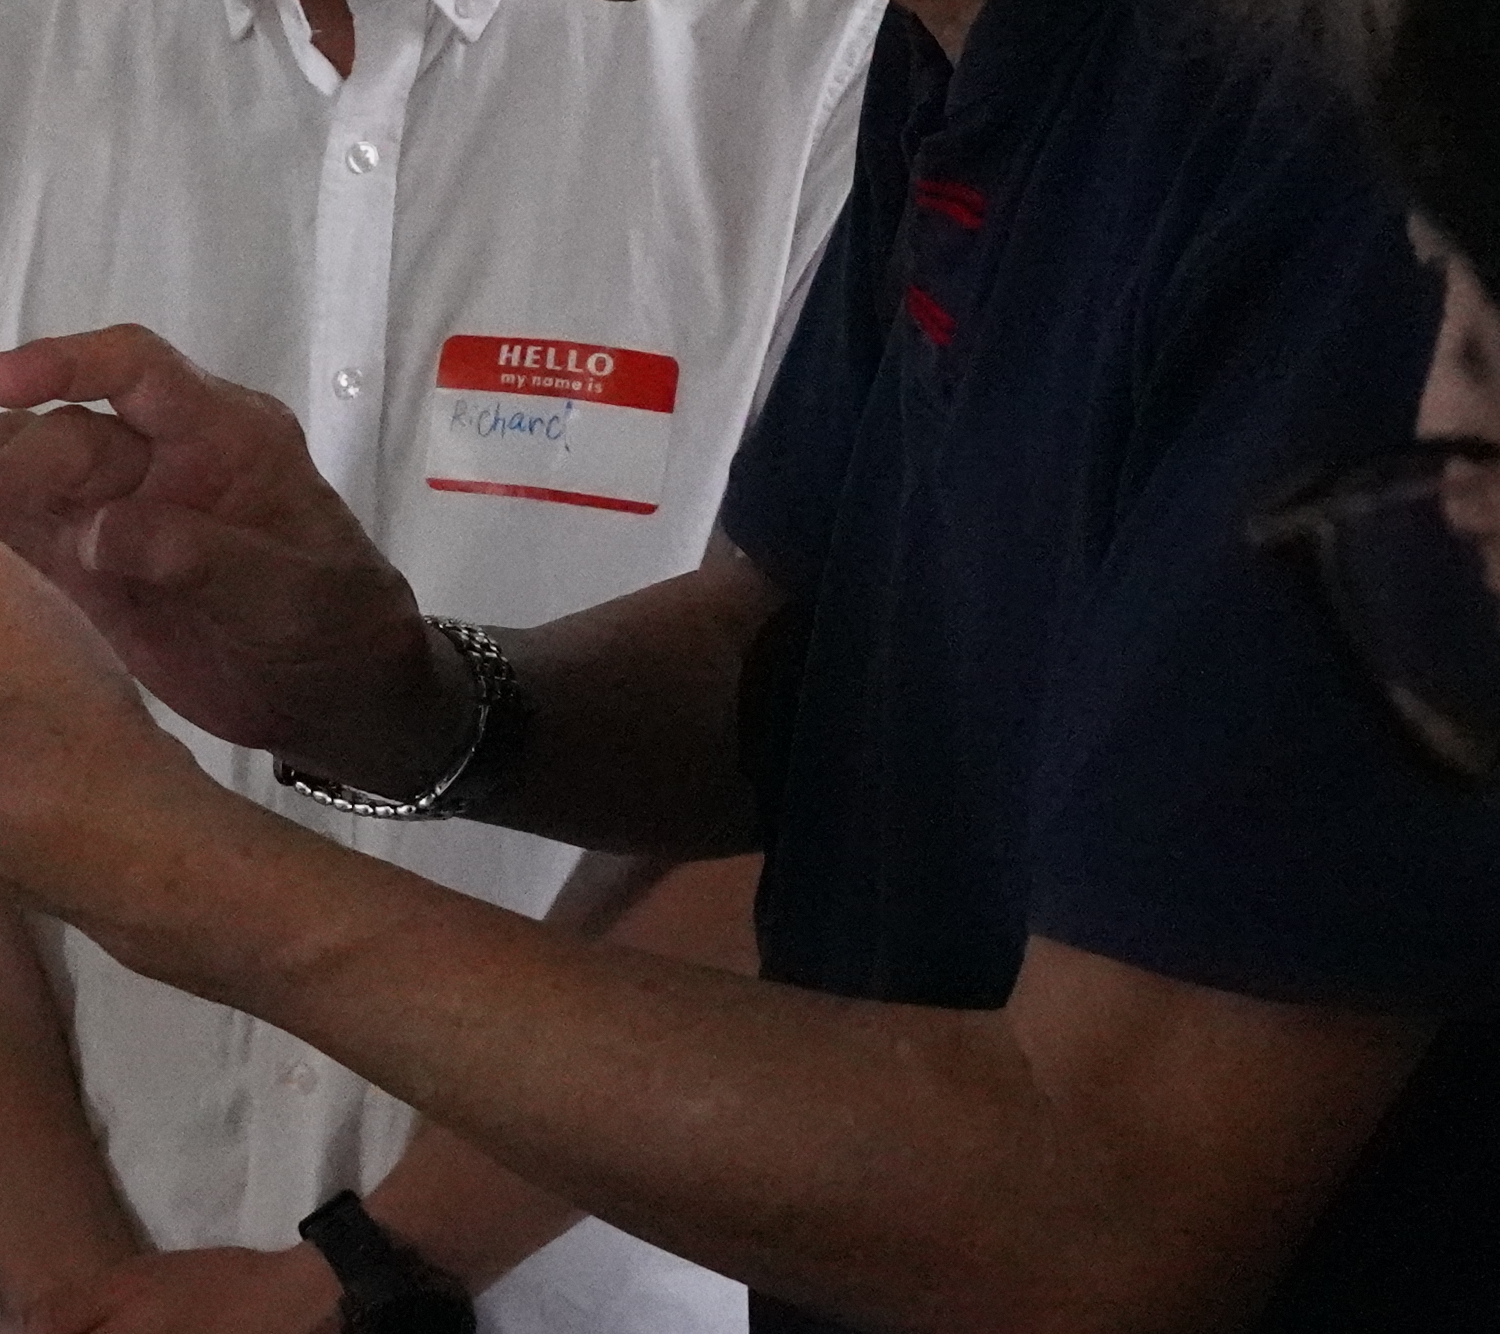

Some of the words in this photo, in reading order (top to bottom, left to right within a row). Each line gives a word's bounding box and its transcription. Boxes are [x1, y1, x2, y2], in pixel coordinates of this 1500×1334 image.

[498, 344, 615, 377] HELLO
[501, 373, 526, 390] my
[531, 375, 583, 392] name
[588, 379, 604, 394] is
[451, 399, 573, 453] Richard
